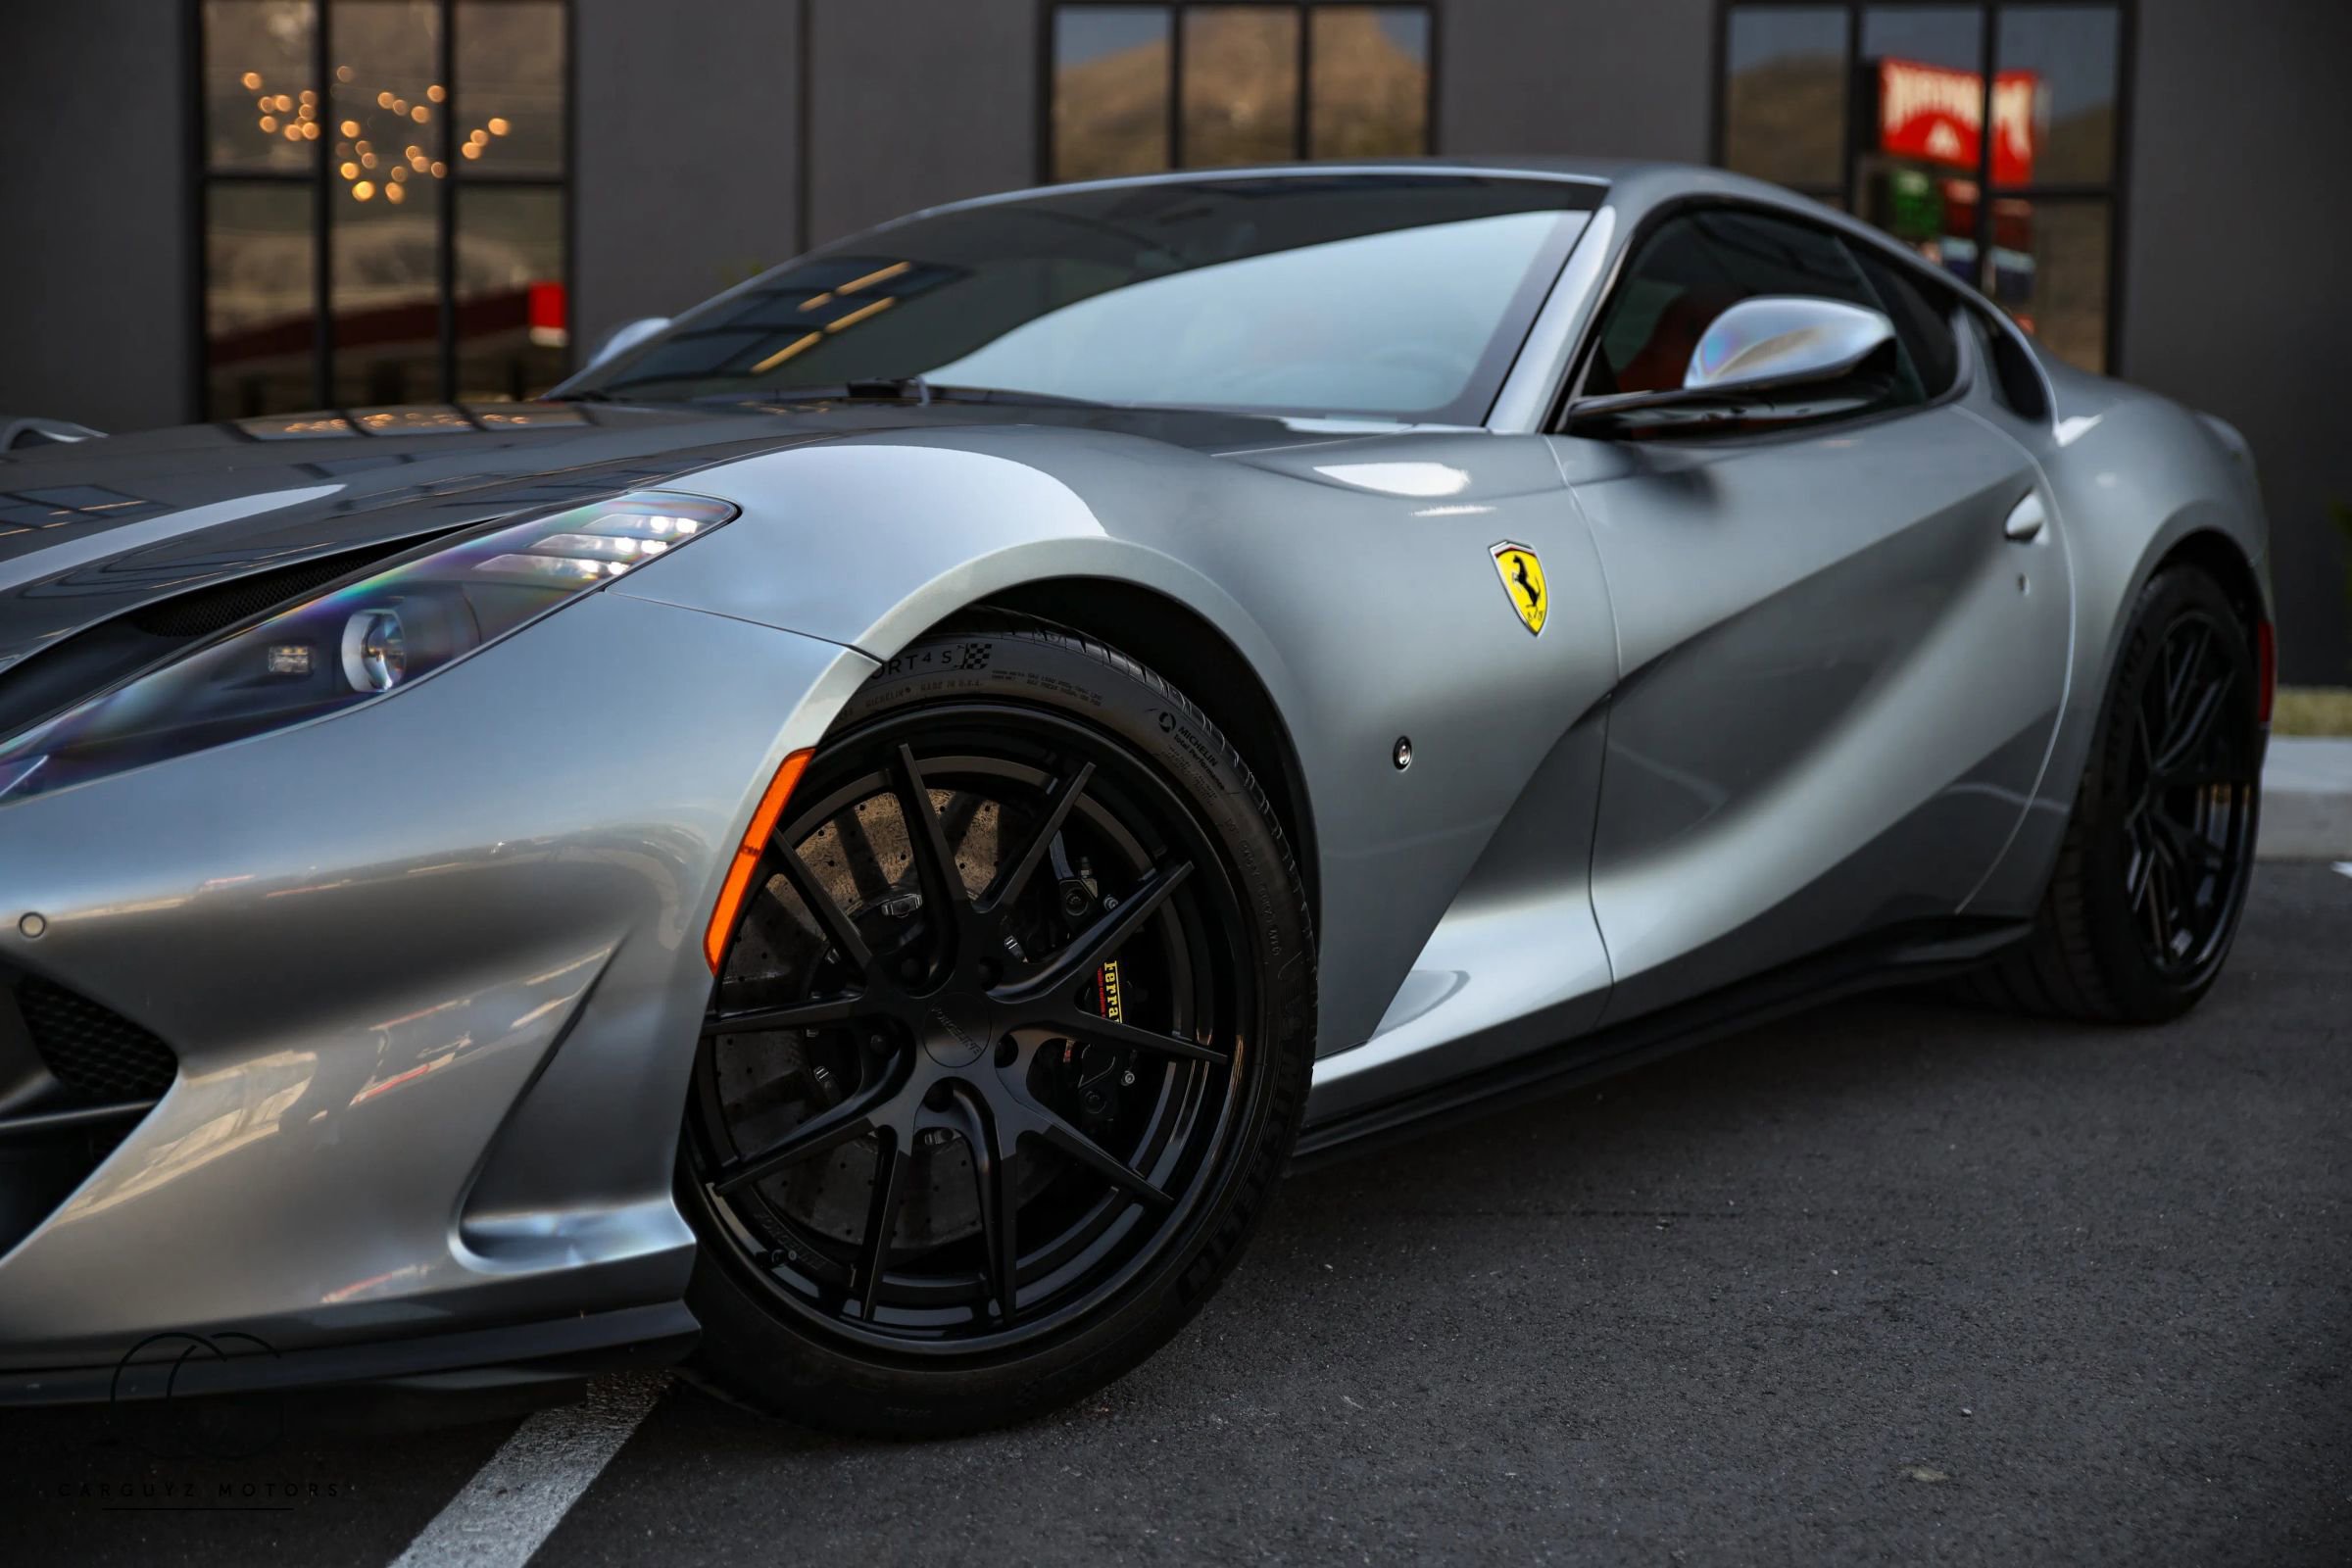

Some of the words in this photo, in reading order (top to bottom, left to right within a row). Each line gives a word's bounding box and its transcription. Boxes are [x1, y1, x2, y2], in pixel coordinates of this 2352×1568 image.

[922, 652, 931, 663] 4
[942, 651, 952, 664] S
[1174, 734, 1190, 751] Total
[1188, 748, 1225, 790] Performance
[1178, 726, 1219, 766] MICHELIN
